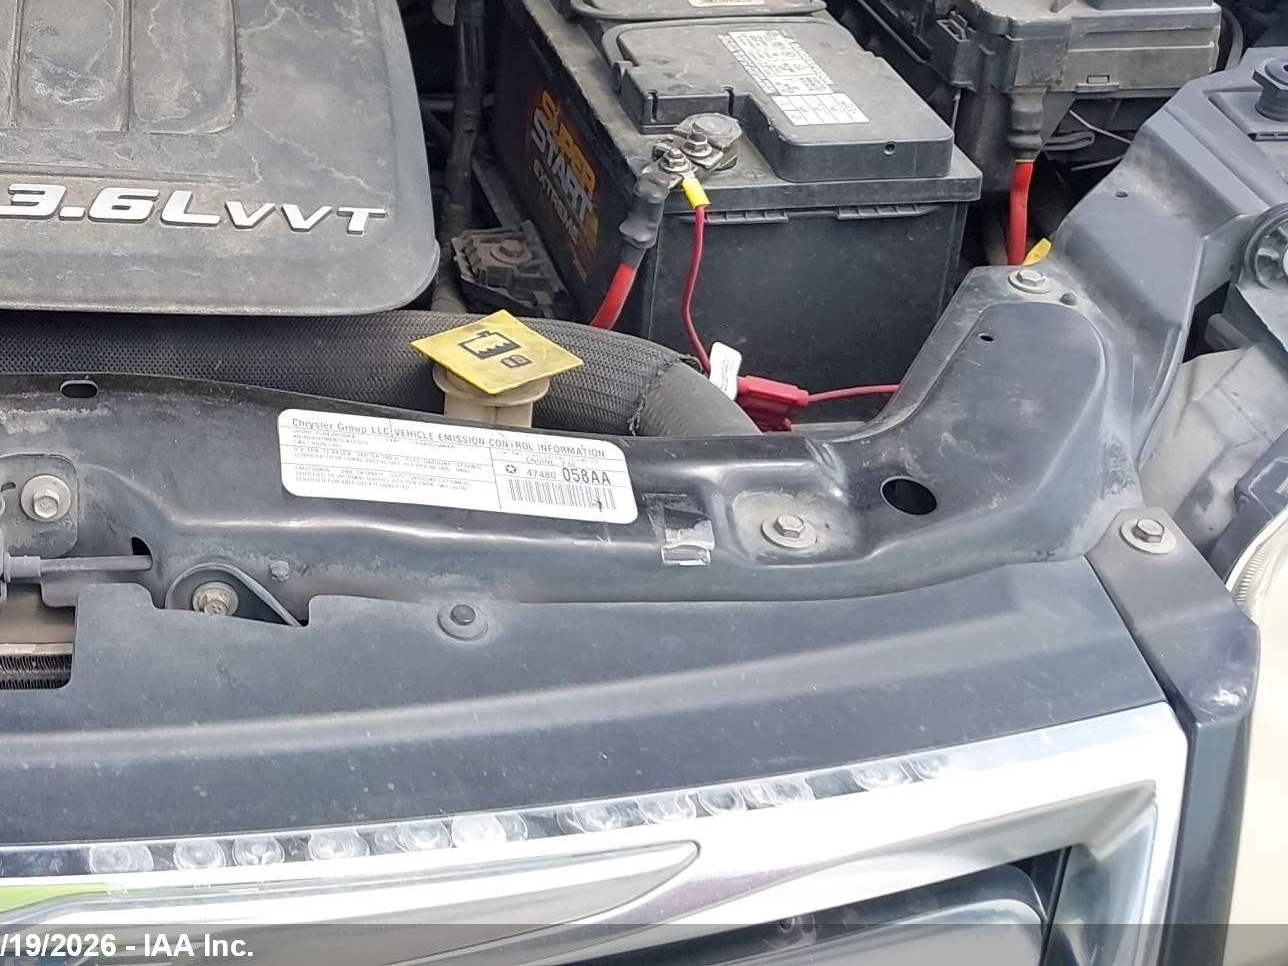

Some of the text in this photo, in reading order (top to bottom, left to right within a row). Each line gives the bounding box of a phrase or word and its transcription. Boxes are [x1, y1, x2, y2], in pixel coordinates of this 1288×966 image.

[531, 107, 593, 227] START
[292, 418, 333, 430] Chrysler
[337, 423, 367, 434] Group
[372, 426, 390, 436] LLC
[393, 428, 434, 440] VEHICLE
[438, 432, 486, 445] EMISSION
[488, 438, 534, 451] CONTROL
[537, 443, 605, 458] INFORMATION
[562, 467, 612, 486] 058AA
